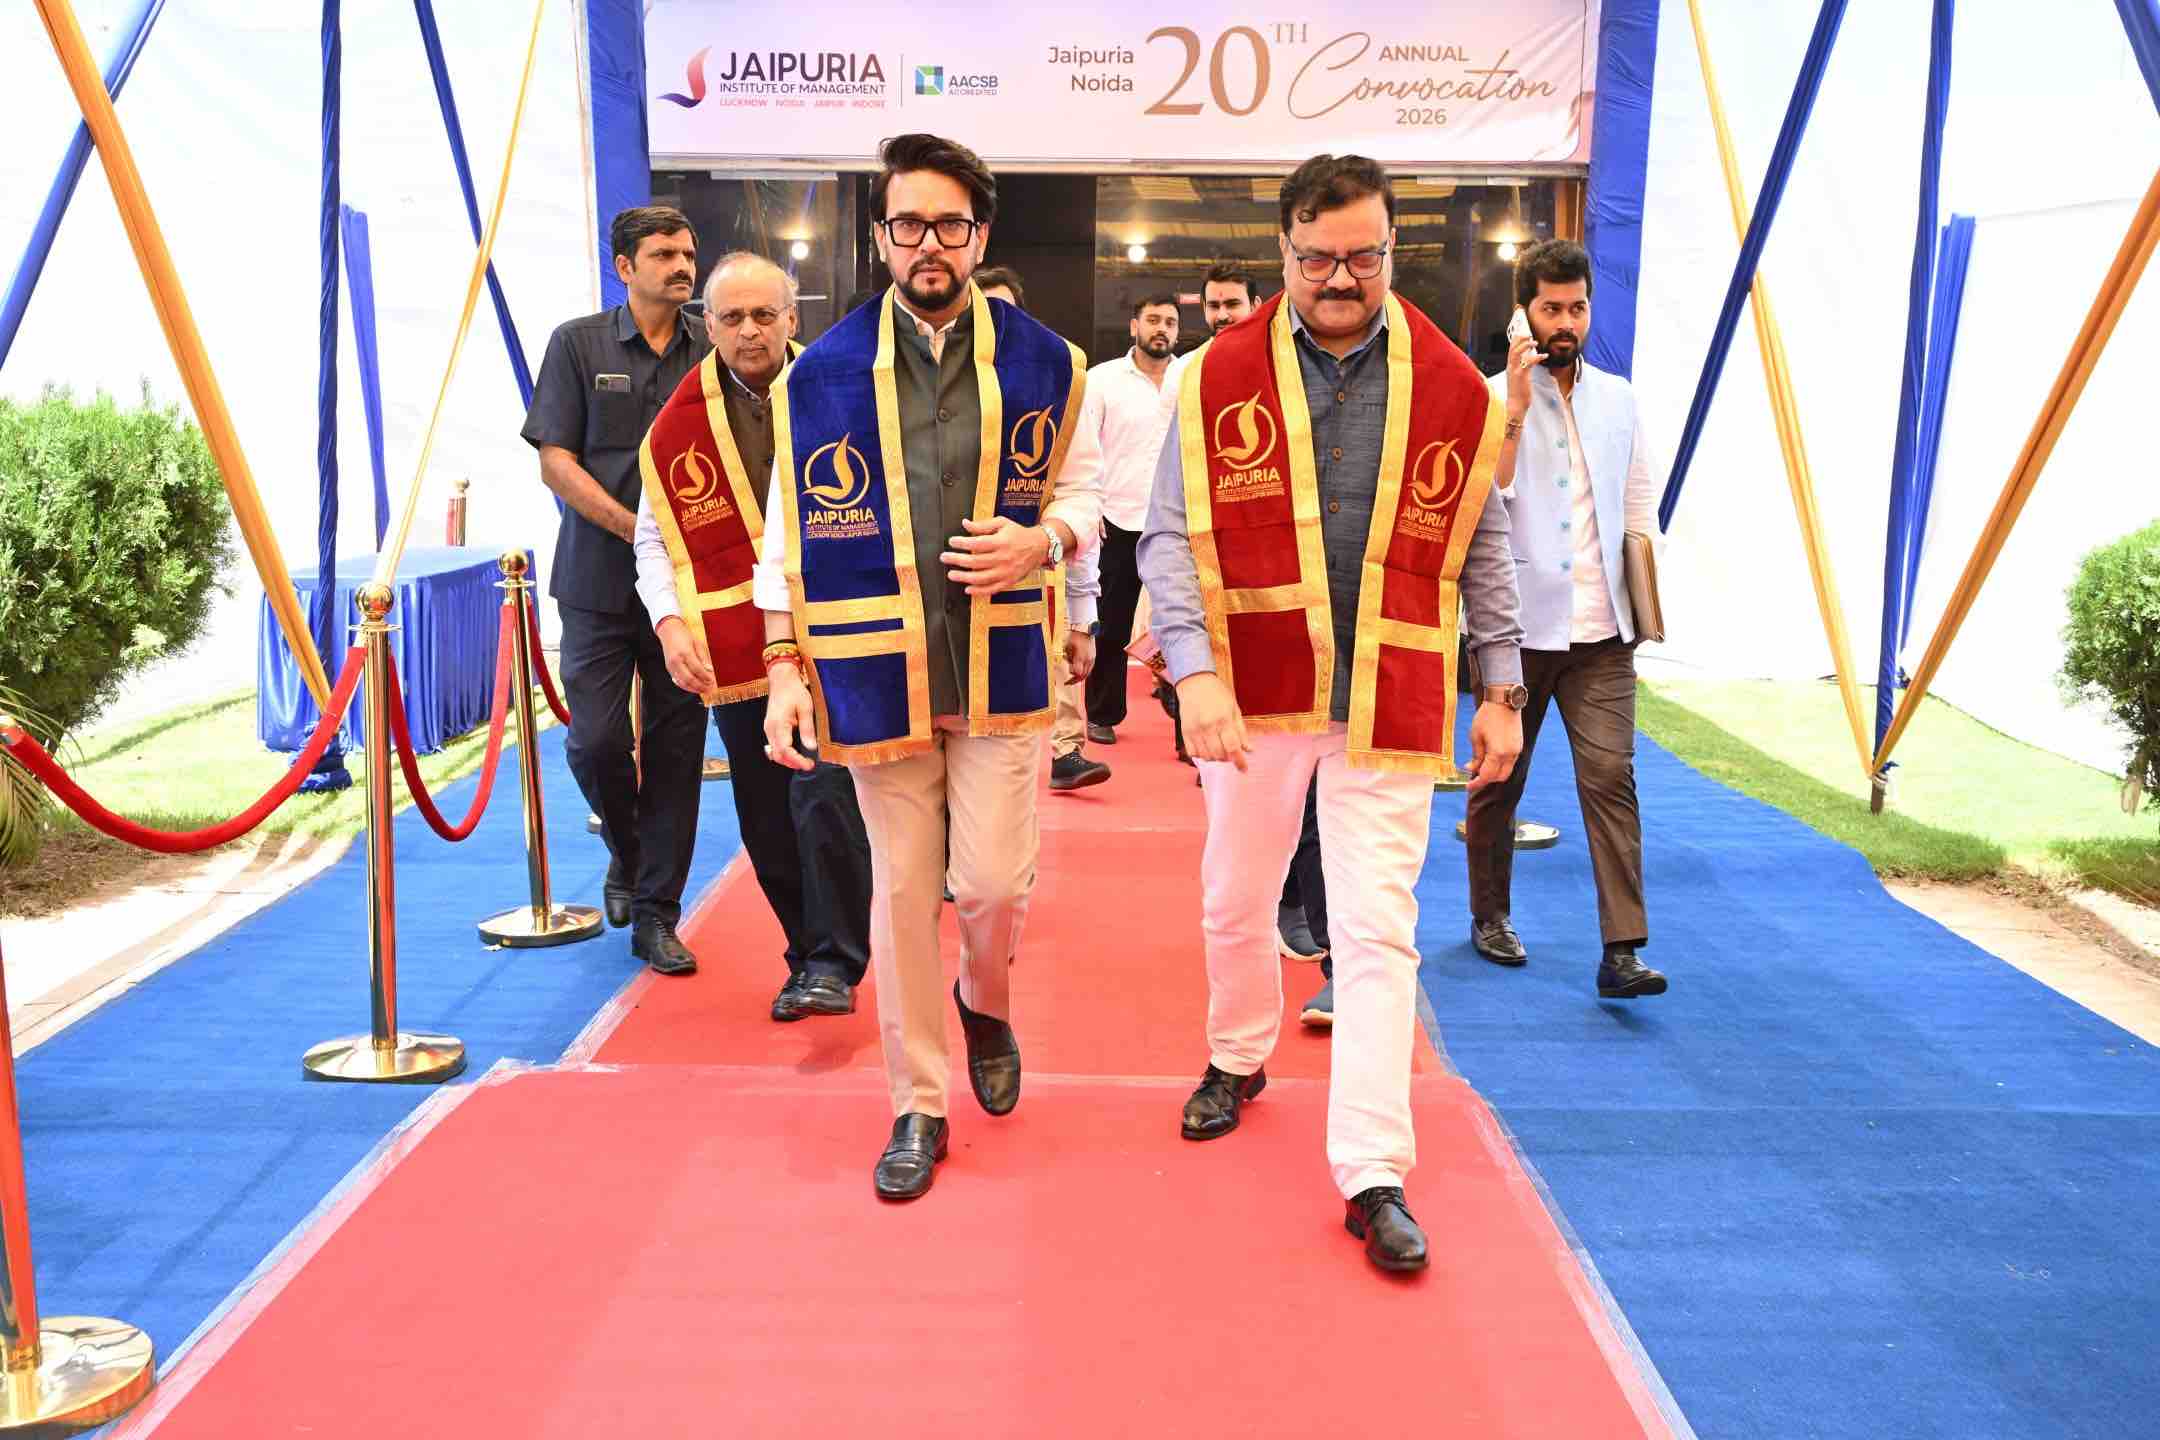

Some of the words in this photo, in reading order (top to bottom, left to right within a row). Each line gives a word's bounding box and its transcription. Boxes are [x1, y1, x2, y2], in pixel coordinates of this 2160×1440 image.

[1048, 46, 1135, 68] Jaipuria
[1378, 46, 1470, 62] ANNUAL
[720, 52, 886, 83] JAIPURIA
[1288, 32, 1556, 119] Convocation
[720, 82, 778, 94] INSTITUTE
[780, 83, 796, 94] OF
[799, 83, 887, 95] MANAGEMENT
[949, 74, 999, 88] AACSB
[1071, 73, 1134, 92] Noida
[1396, 107, 1448, 125] 2026
[1215, 466, 1281, 490] JAIPURIA
[806, 507, 876, 525] JAIPURIA
